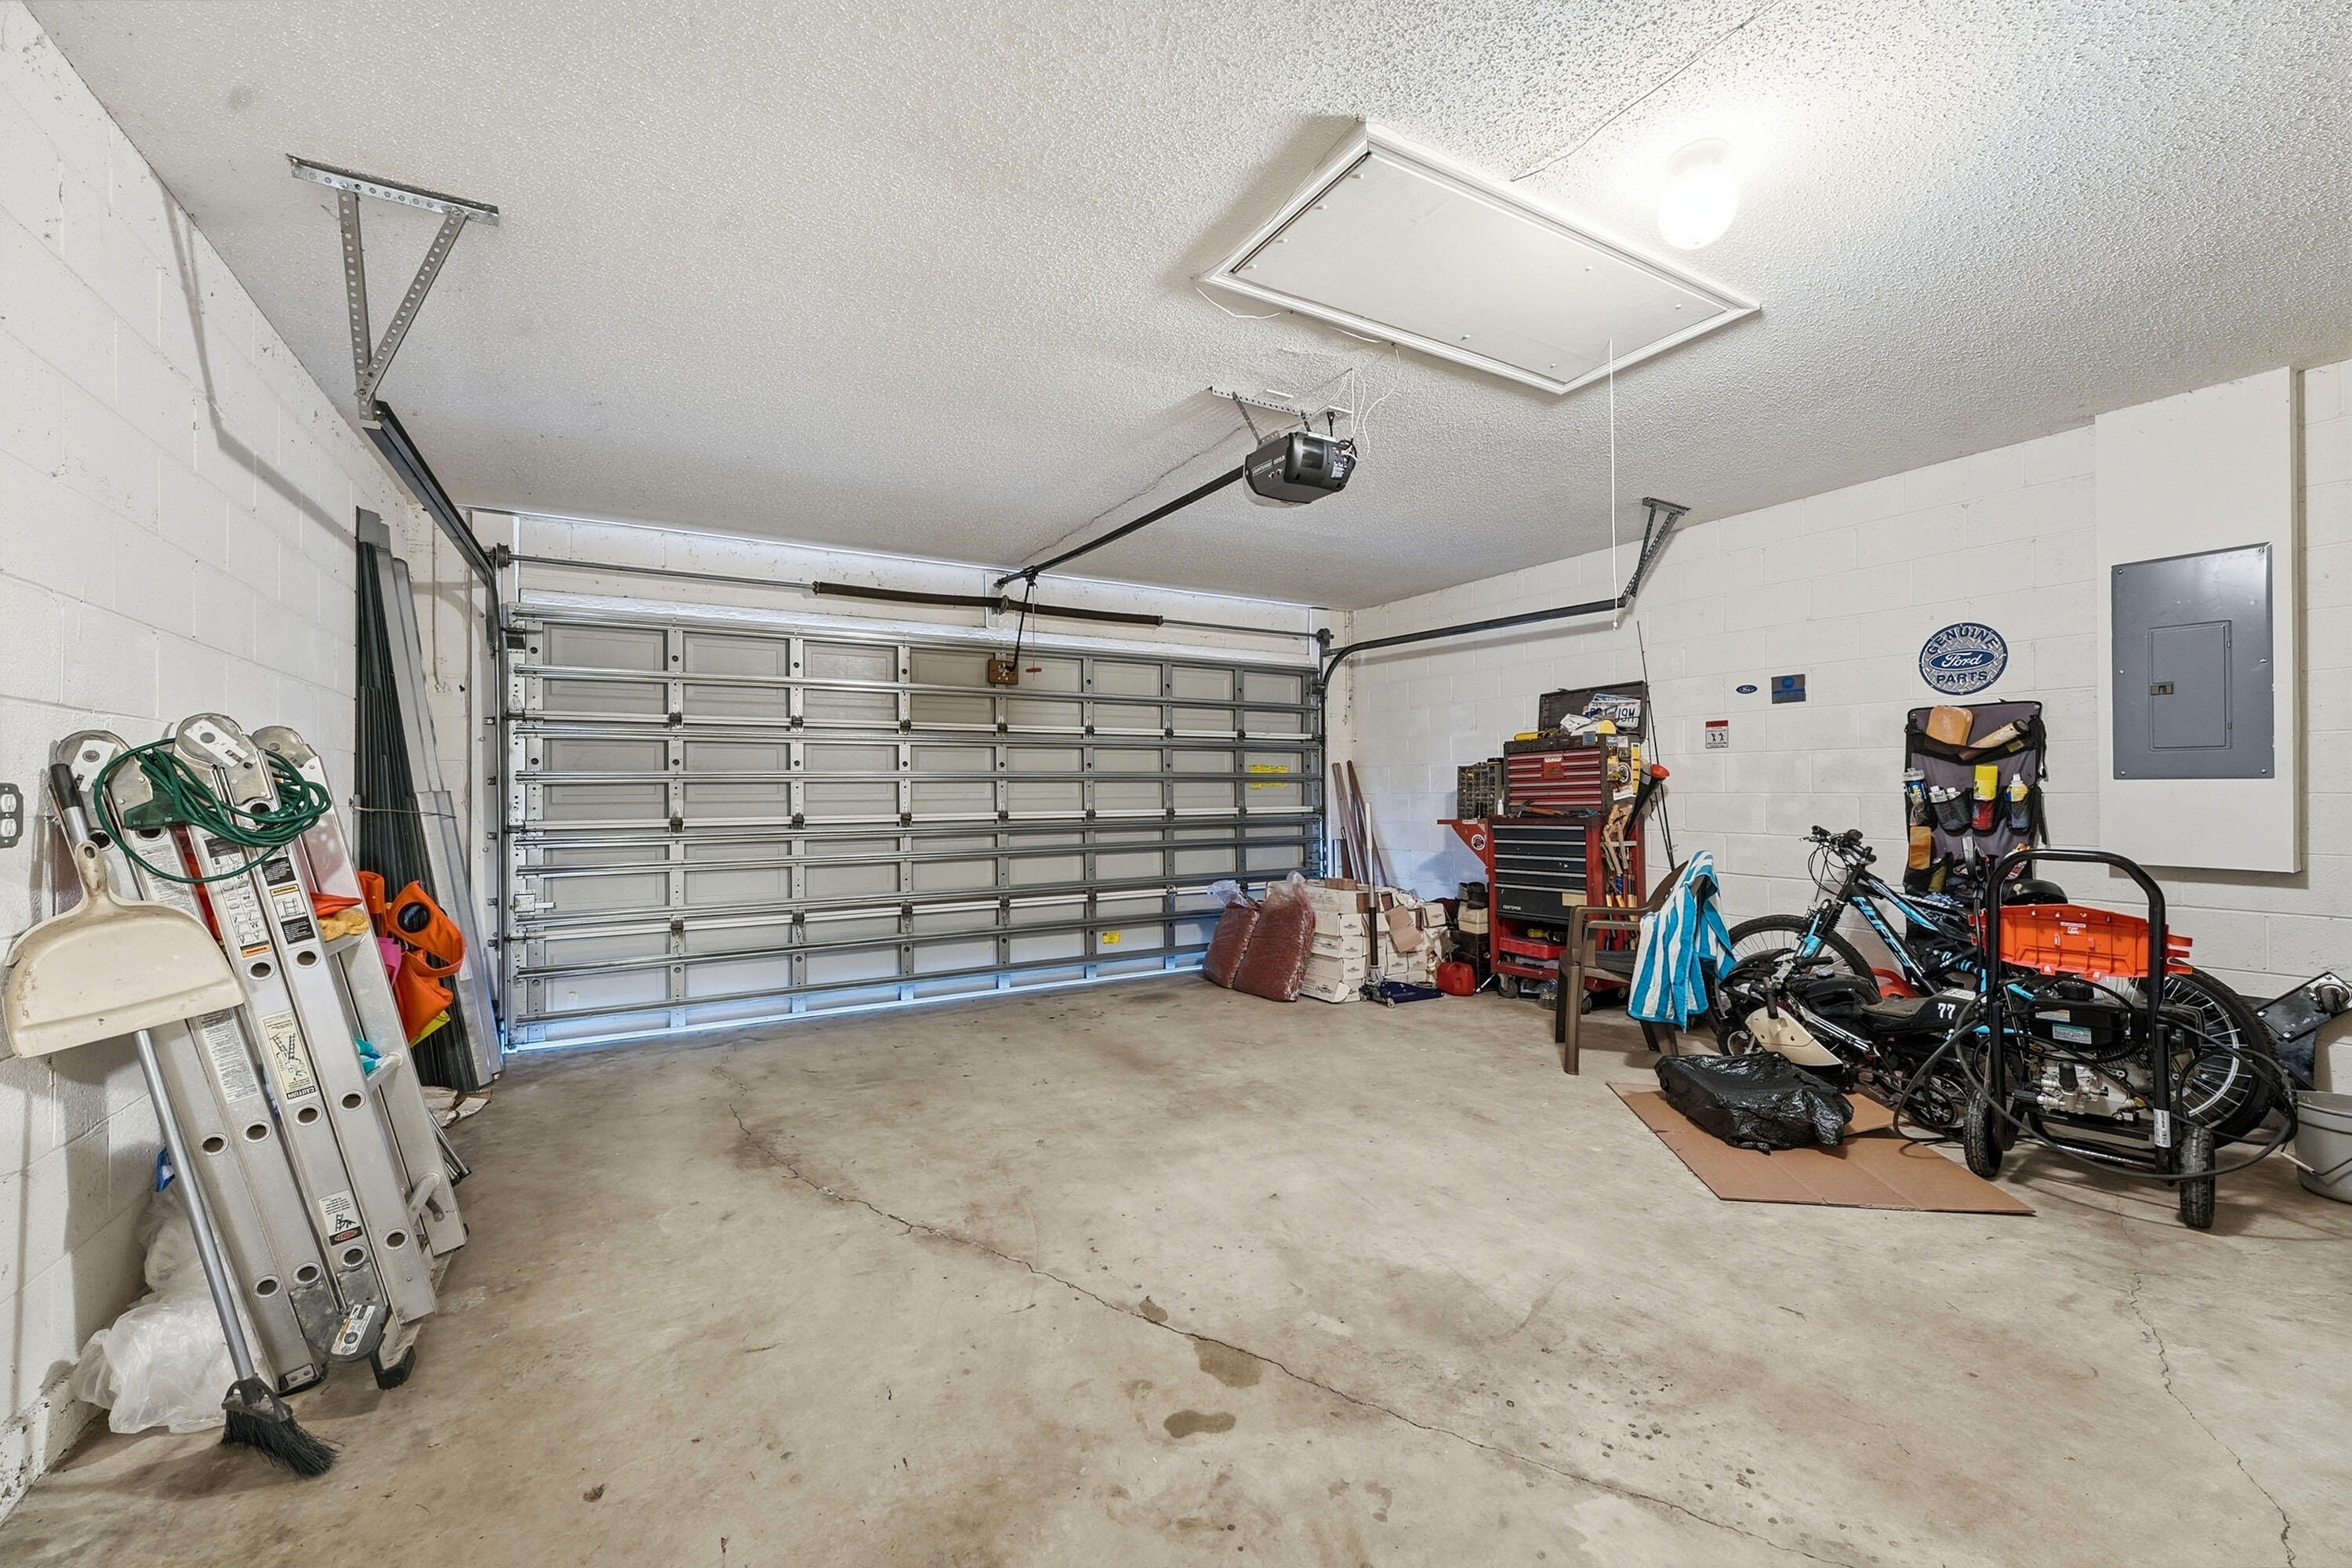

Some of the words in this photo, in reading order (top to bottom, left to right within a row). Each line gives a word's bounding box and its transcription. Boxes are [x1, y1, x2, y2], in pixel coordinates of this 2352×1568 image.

[1927, 626, 2000, 655] GENUINE
[1941, 652, 1983, 668] Ford
[1936, 671, 1988, 684] PARTS
[1937, 1003, 1956, 1019] 77
